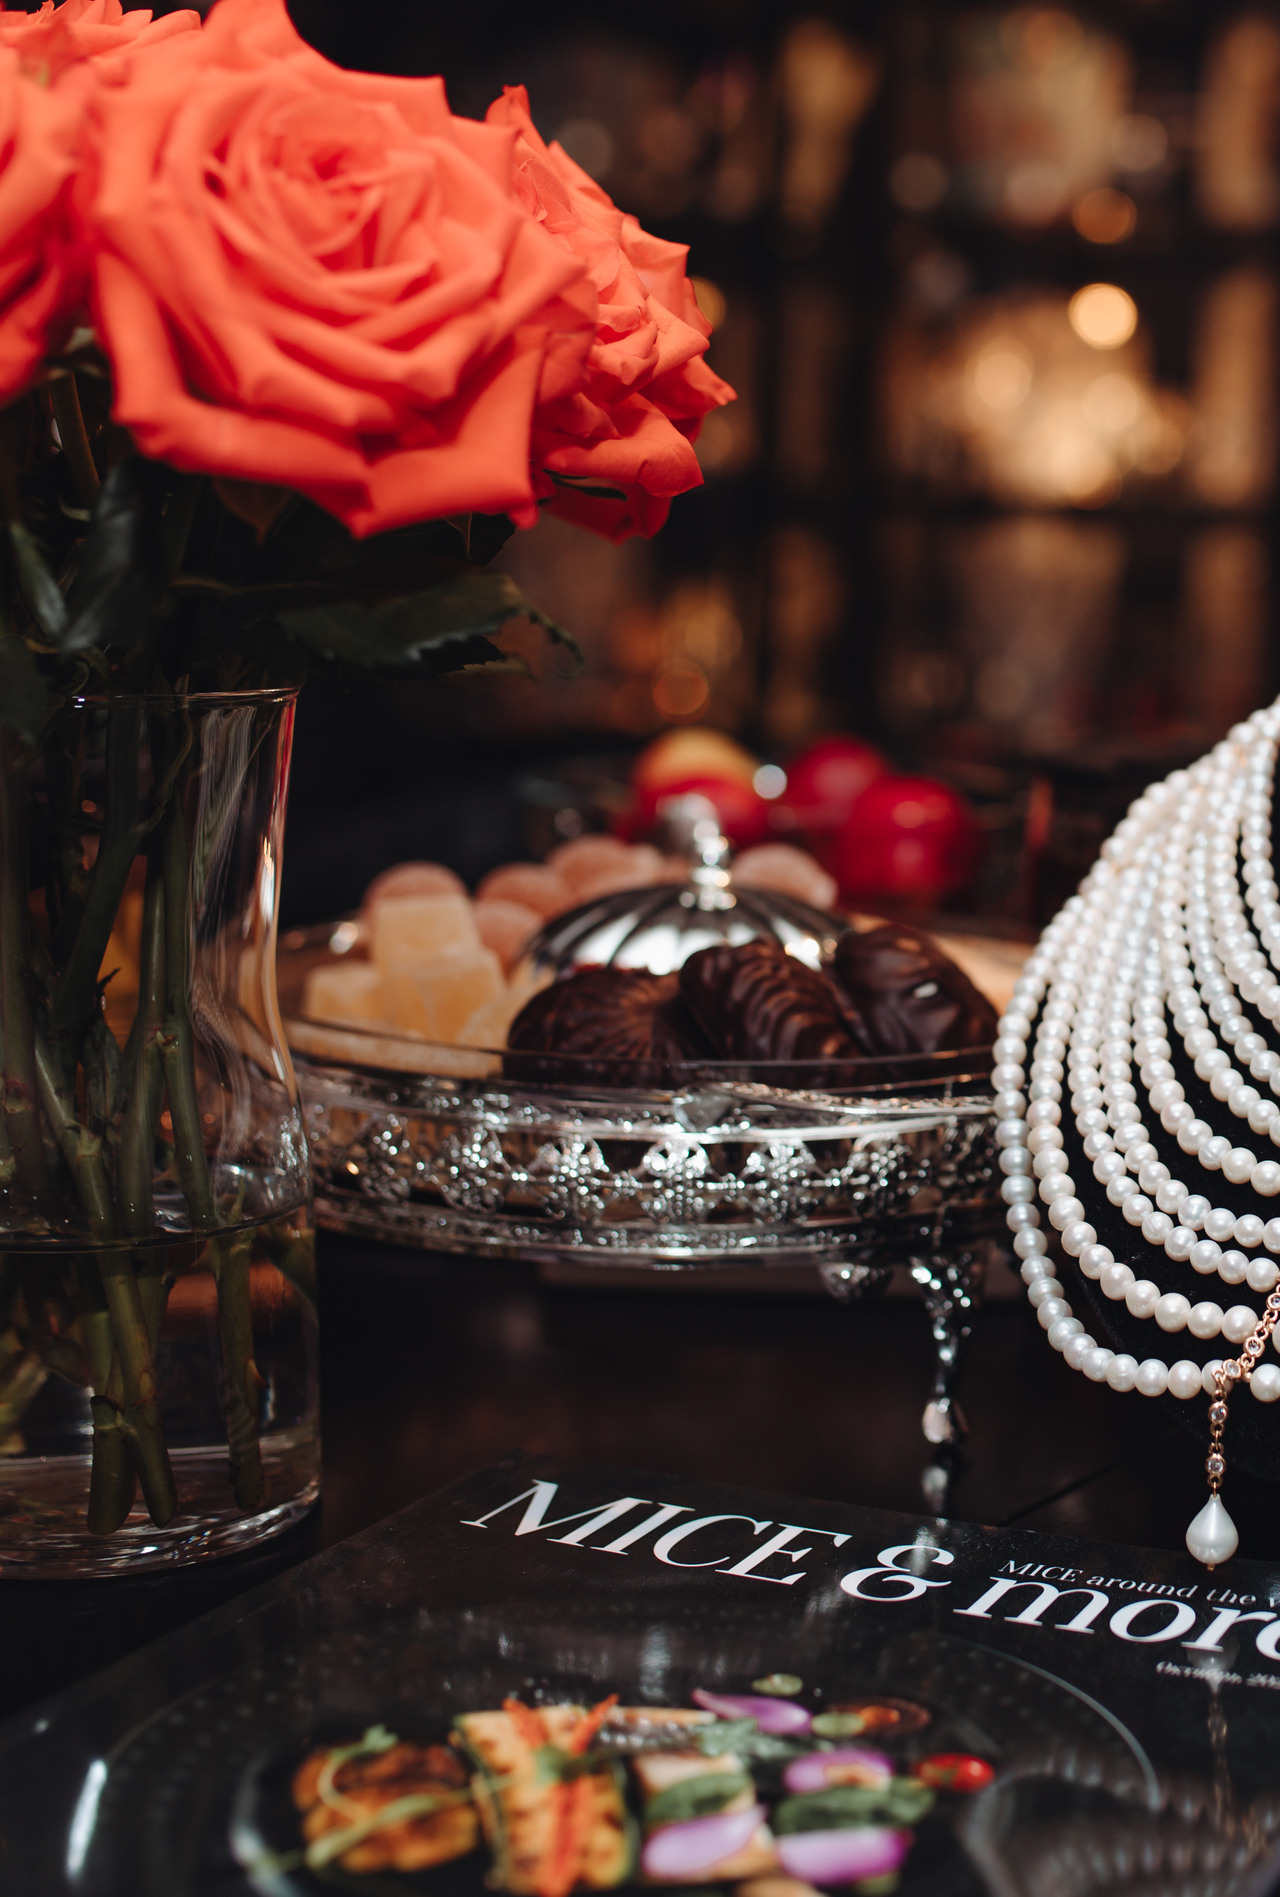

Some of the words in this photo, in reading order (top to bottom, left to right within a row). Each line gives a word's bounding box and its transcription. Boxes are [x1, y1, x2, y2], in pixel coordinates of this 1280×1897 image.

[460, 1479, 852, 1586] MICE
[840, 1544, 955, 1602] &
[998, 1560, 1083, 1582] MICE
[1087, 1576, 1198, 1599] around
[1206, 1588, 1256, 1606] the
